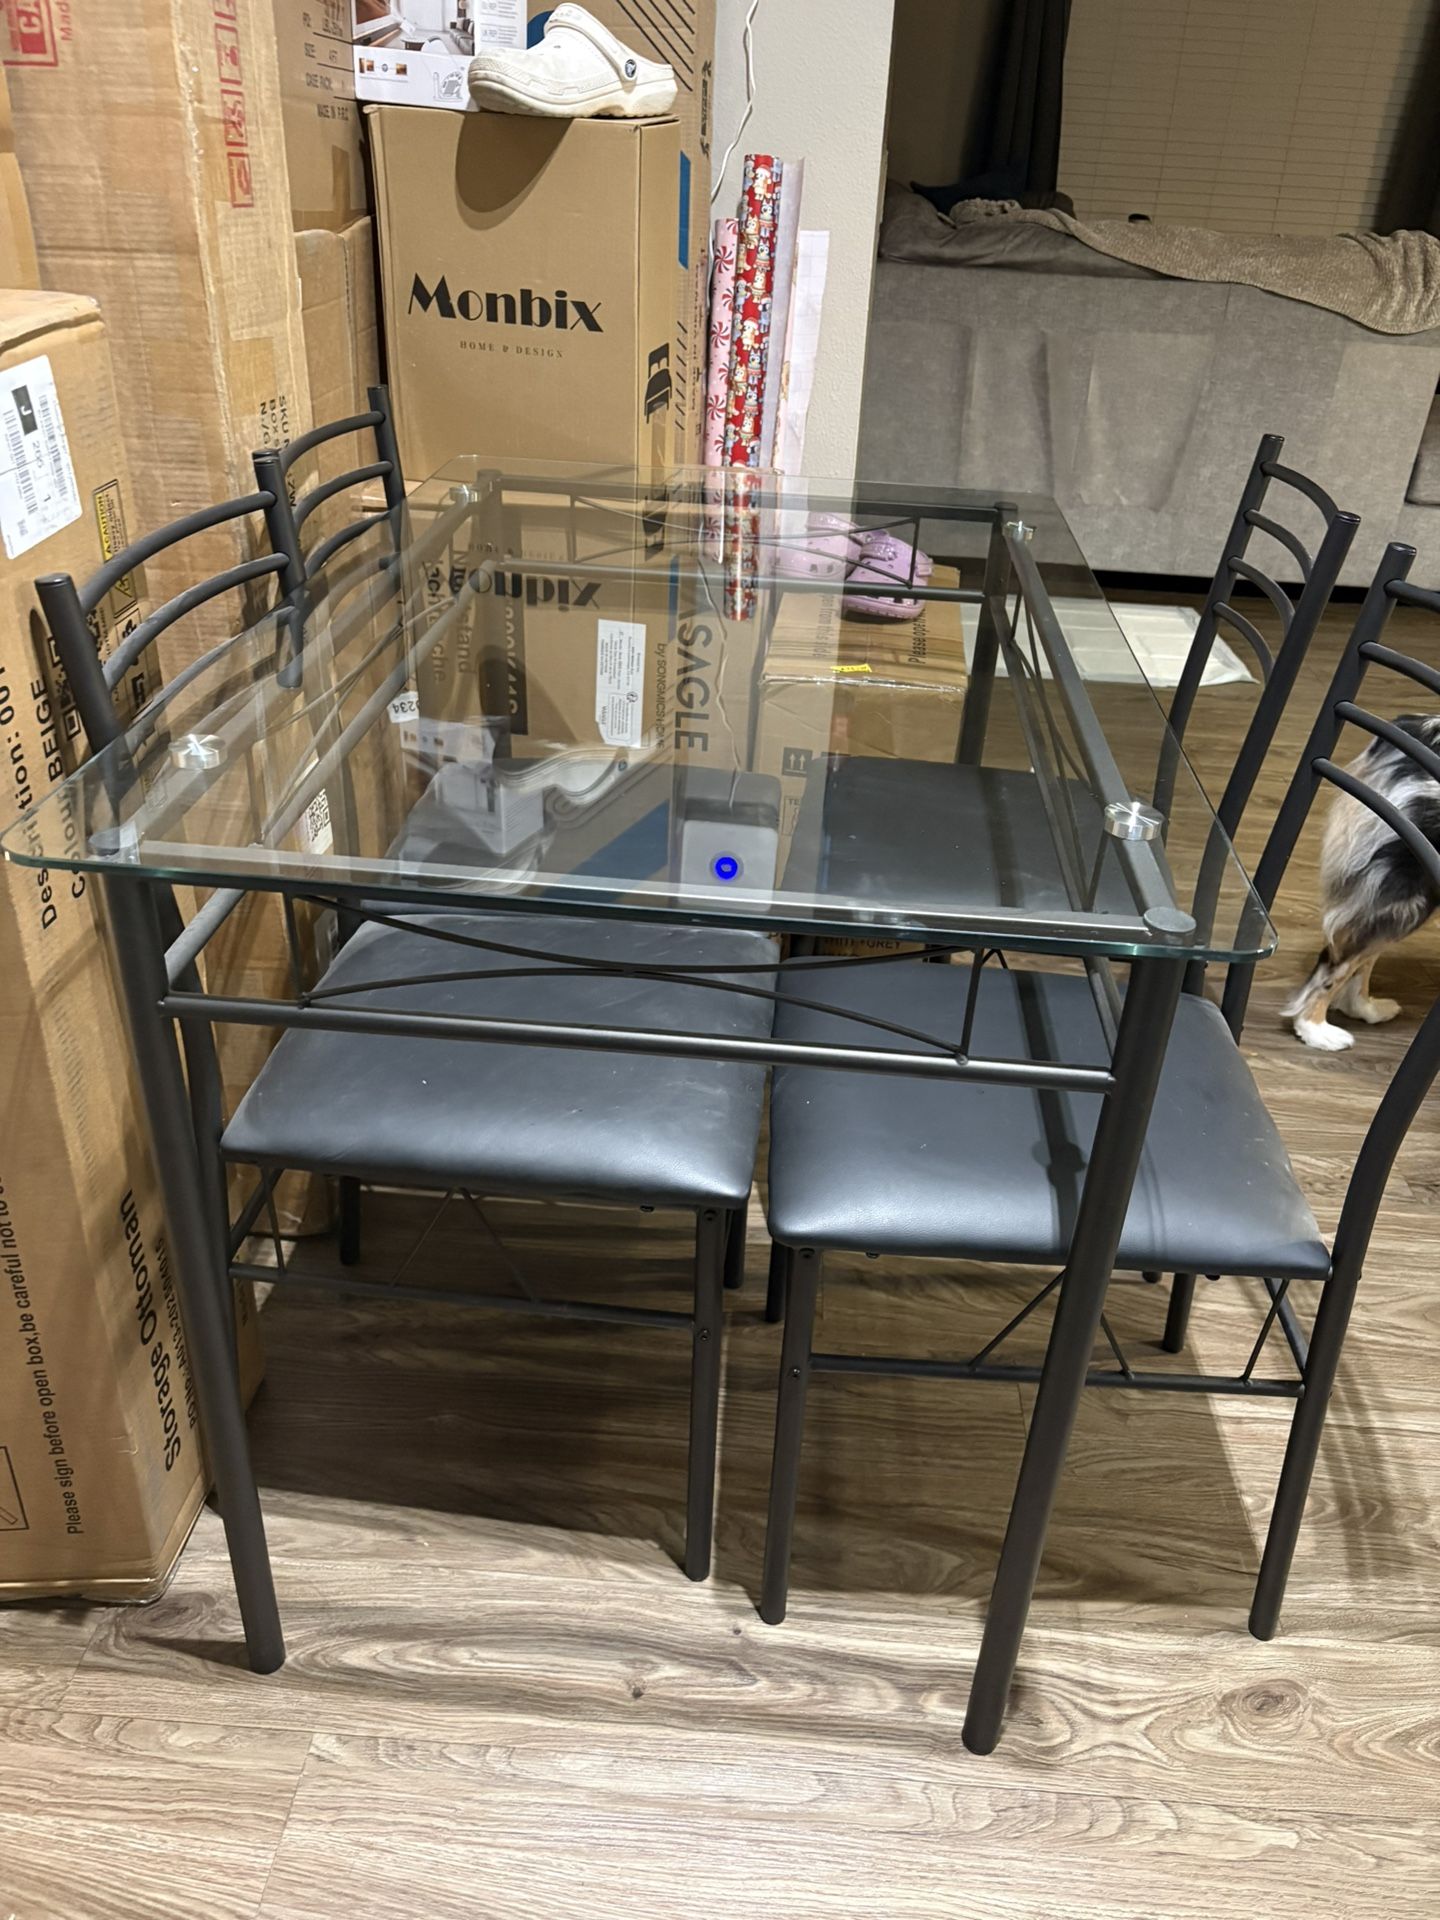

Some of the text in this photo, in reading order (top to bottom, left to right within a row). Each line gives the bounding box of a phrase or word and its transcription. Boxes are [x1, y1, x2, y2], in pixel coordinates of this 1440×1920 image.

[408, 271, 604, 333] Monbix
[459, 340, 495, 352] HOME
[516, 346, 563, 359] DESIGN
[20, 404, 32, 416] J
[269, 398, 279, 434] BOX
[279, 395, 289, 434] SKU
[97, 496, 110, 544] CAUTION
[655, 643, 667, 659] by
[908, 637, 926, 665] Please
[30, 678, 66, 782] BEIGE
[0, 665, 58, 930] Descrition: 00
[0, 1221, 17, 1249] not
[4, 1253, 31, 1310] careful
[120, 1188, 181, 1473] Storage Ottoman
[34, 1369, 57, 1407] open
[43, 1409, 64, 1457] before
[53, 1458, 75, 1488] sign
[66, 1491, 84, 1535] Please
